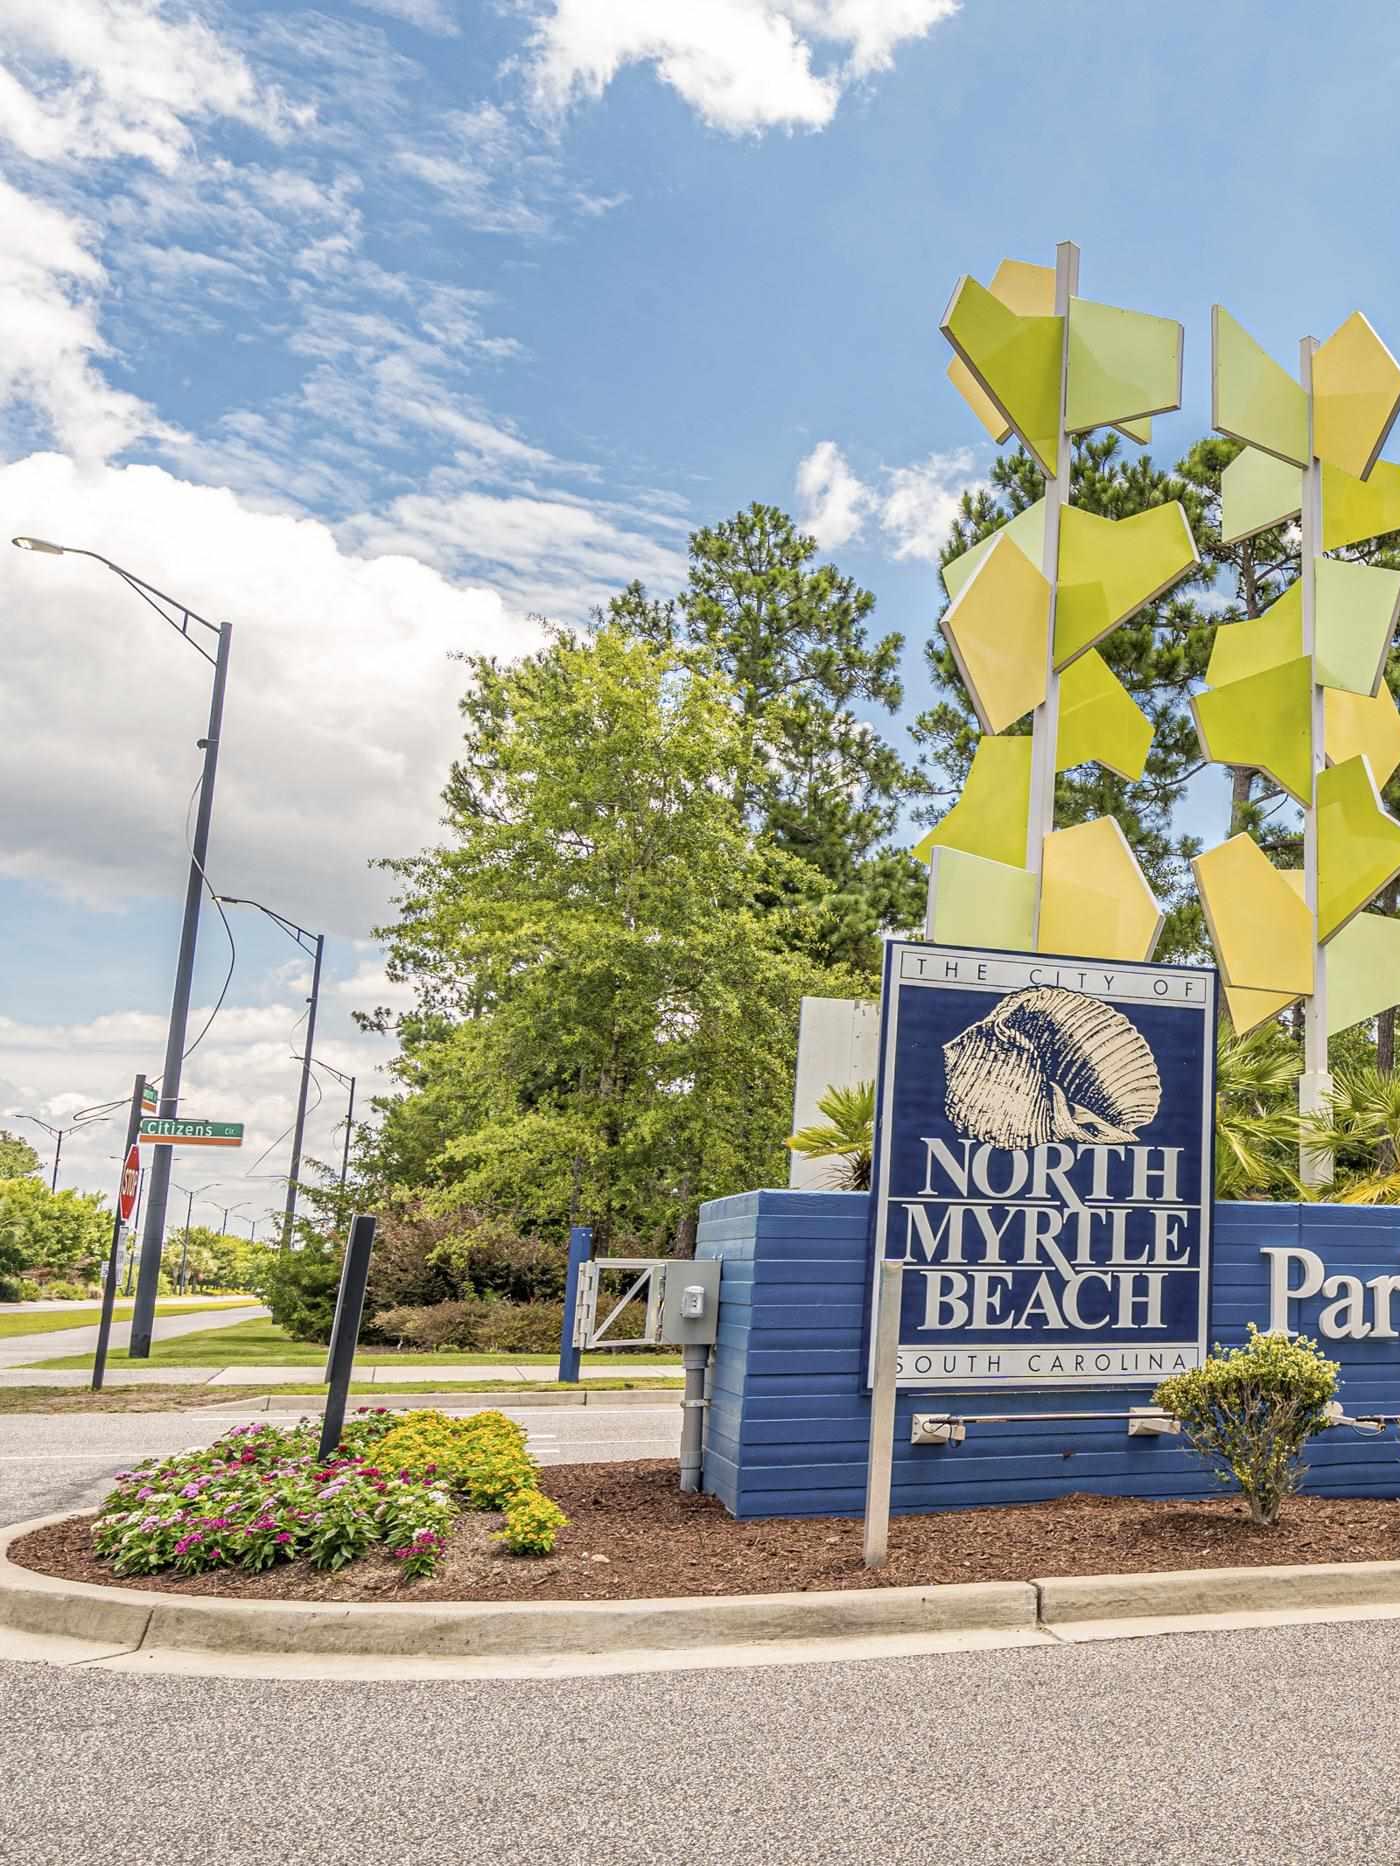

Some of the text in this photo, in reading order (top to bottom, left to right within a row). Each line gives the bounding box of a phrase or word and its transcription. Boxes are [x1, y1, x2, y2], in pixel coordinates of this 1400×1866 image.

[916, 958, 1194, 997] THE CITY OF
[147, 1121, 213, 1136] Citizens
[122, 1168, 138, 1196] STOP
[917, 1137, 1184, 1207] NORTH
[902, 1204, 1191, 1281] MYRTLE
[917, 1270, 1169, 1330] BEACH
[1028, 1353, 1186, 1373] CAROLINA
